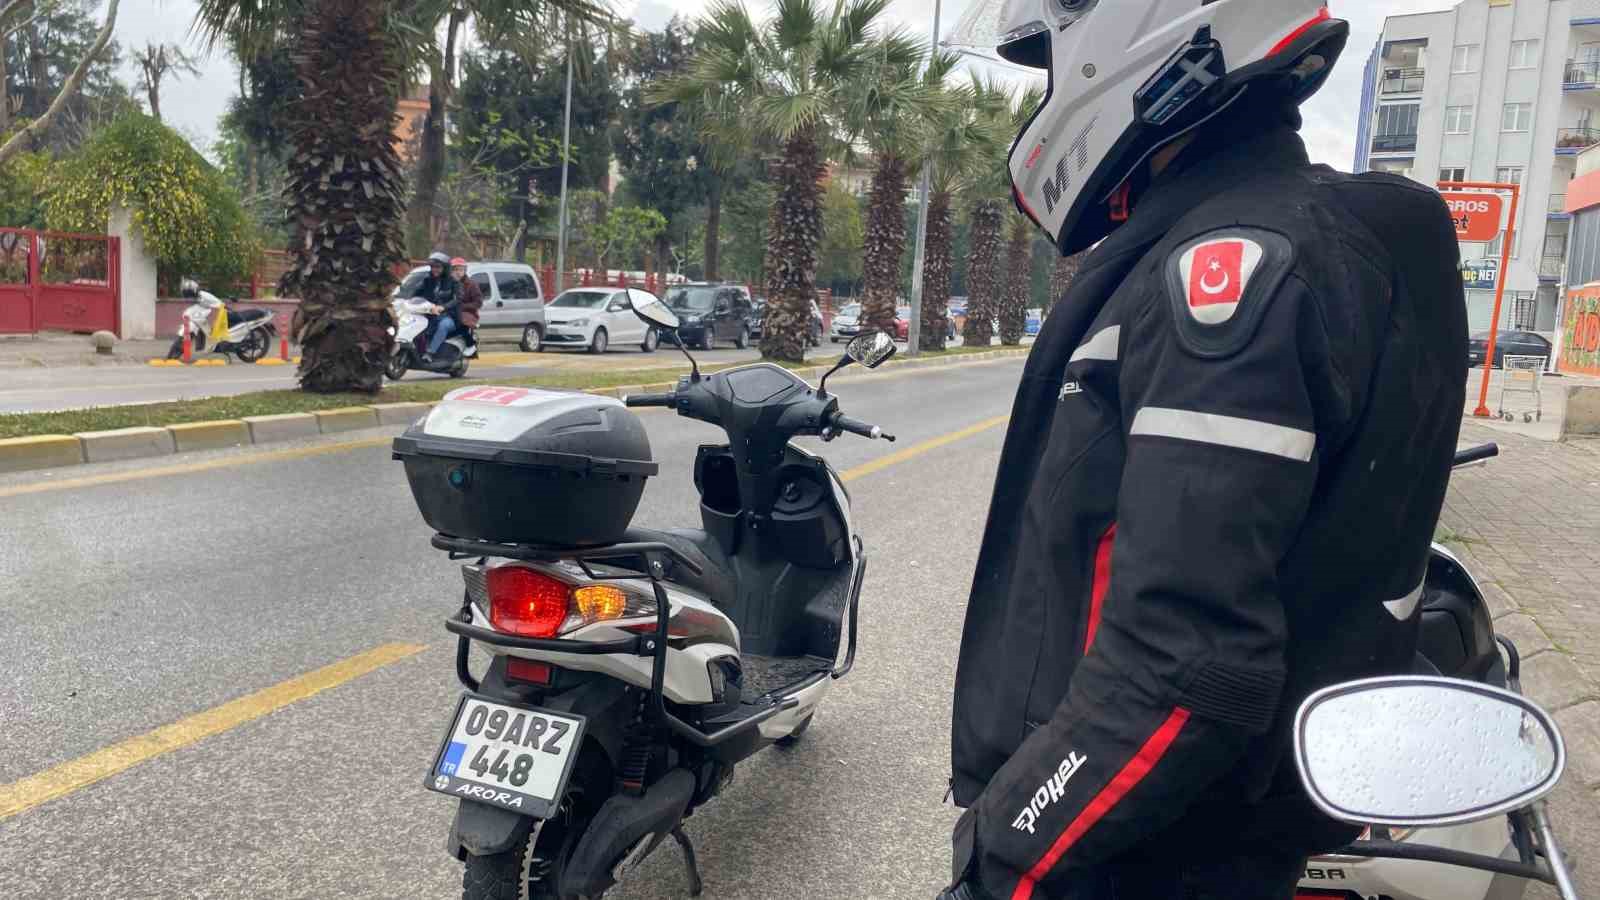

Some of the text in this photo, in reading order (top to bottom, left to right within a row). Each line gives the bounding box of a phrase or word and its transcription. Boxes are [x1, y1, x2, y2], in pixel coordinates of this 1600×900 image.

[1042, 118, 1097, 215] MT
[1479, 269, 1495, 281] NET
[465, 705, 570, 755] 09ARZ
[469, 744, 534, 787] 448
[456, 783, 523, 807] ARORA
[1307, 868, 1345, 880] BA
